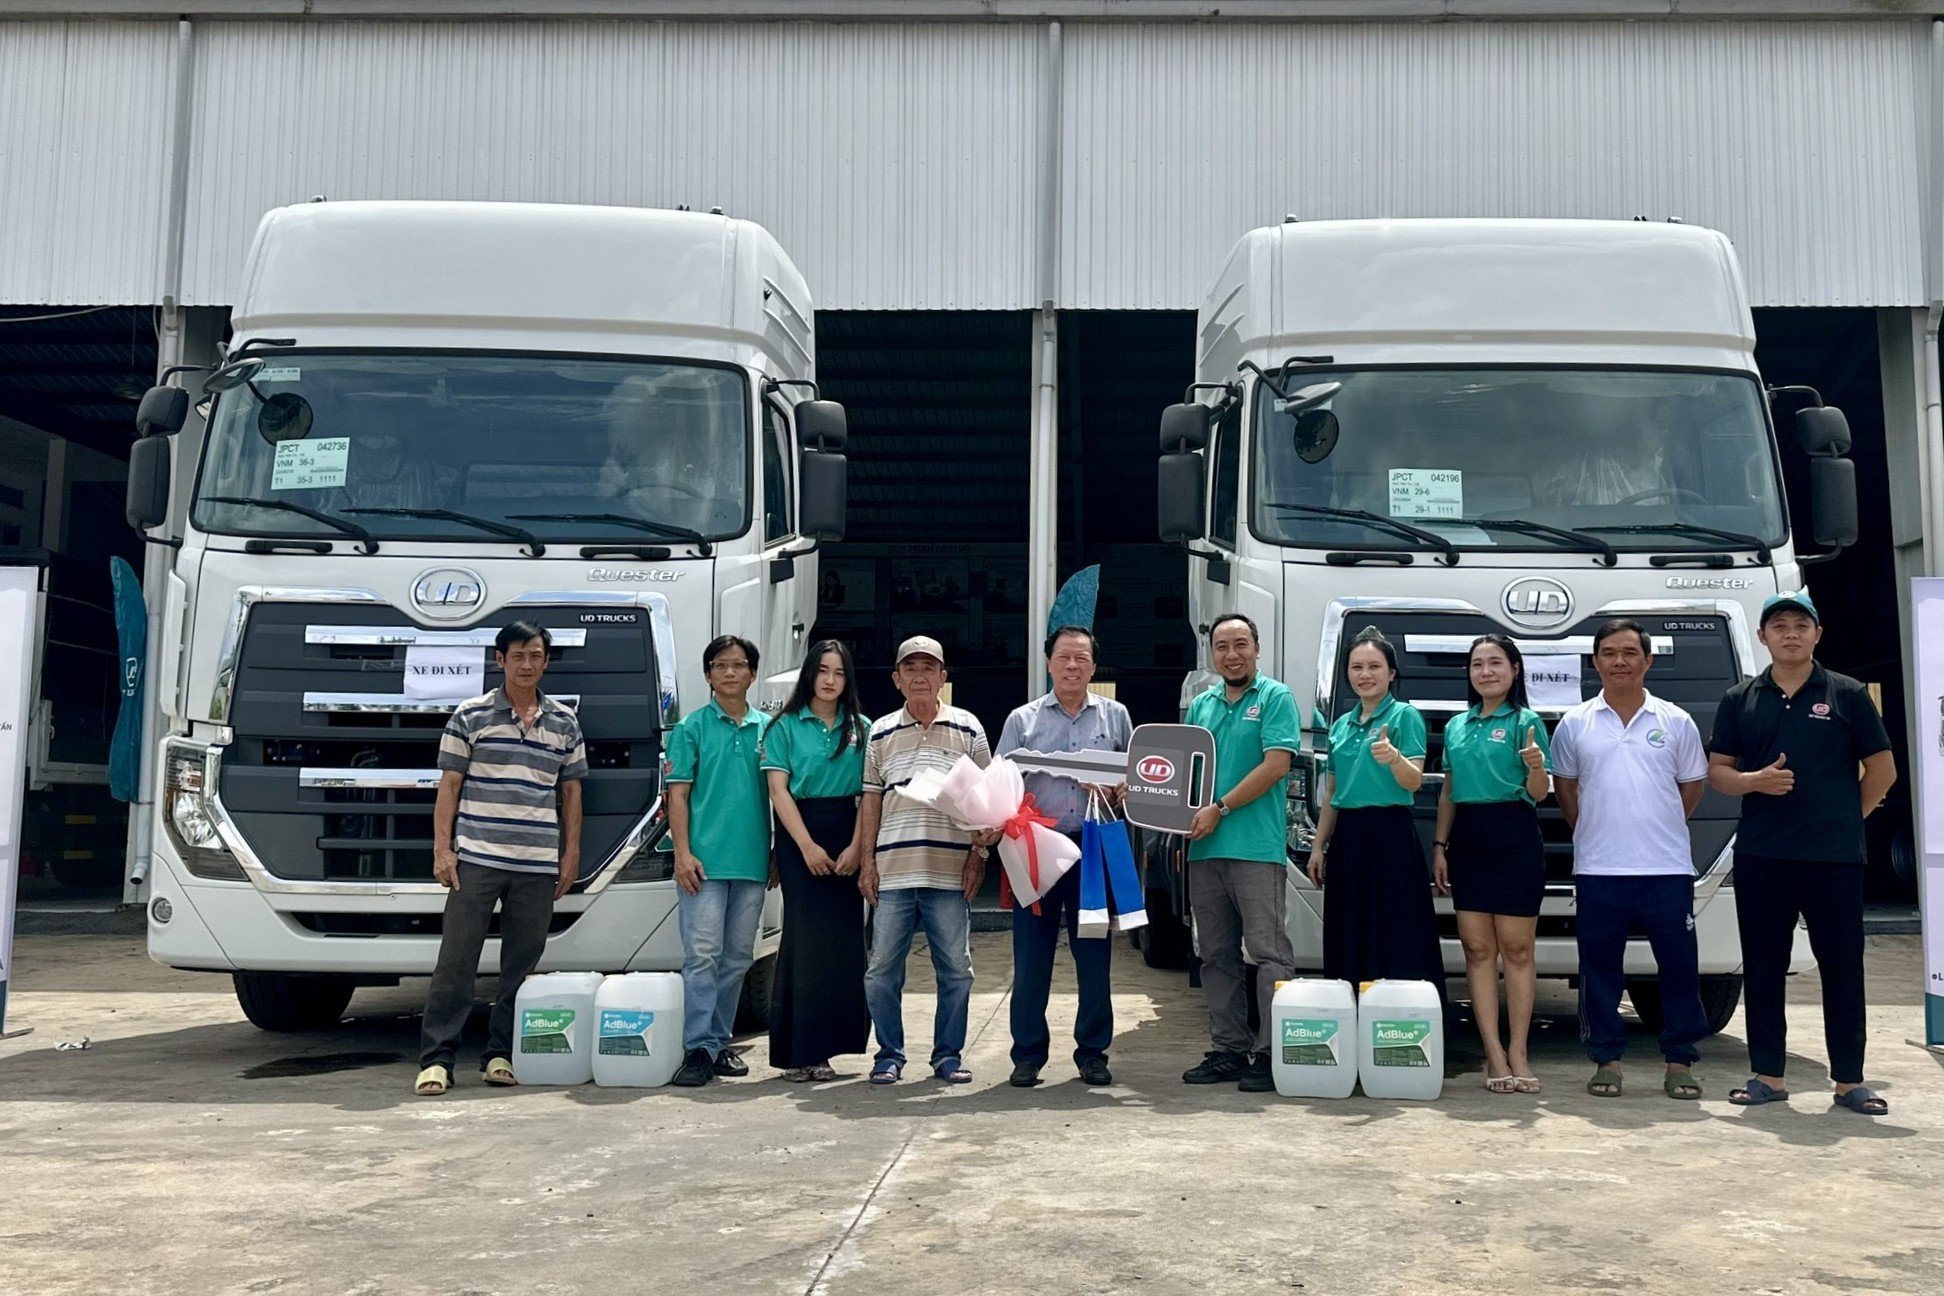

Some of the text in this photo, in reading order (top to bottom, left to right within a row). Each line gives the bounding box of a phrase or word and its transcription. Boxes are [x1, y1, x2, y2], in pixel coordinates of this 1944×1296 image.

[278, 442, 347, 453] JPCT 042736
[1392, 472, 1459, 482] JPCT 042196
[587, 567, 685, 582] Quester
[1665, 576, 1754, 590] Quester
[415, 581, 481, 605] UD
[1507, 590, 1569, 614] UD
[580, 614, 636, 622] UD TRUCKS
[1664, 622, 1715, 630] UD TRUCKS
[412, 665, 428, 675] XE
[1140, 762, 1171, 777] UD
[1128, 784, 1179, 797] UD TRUCKS
